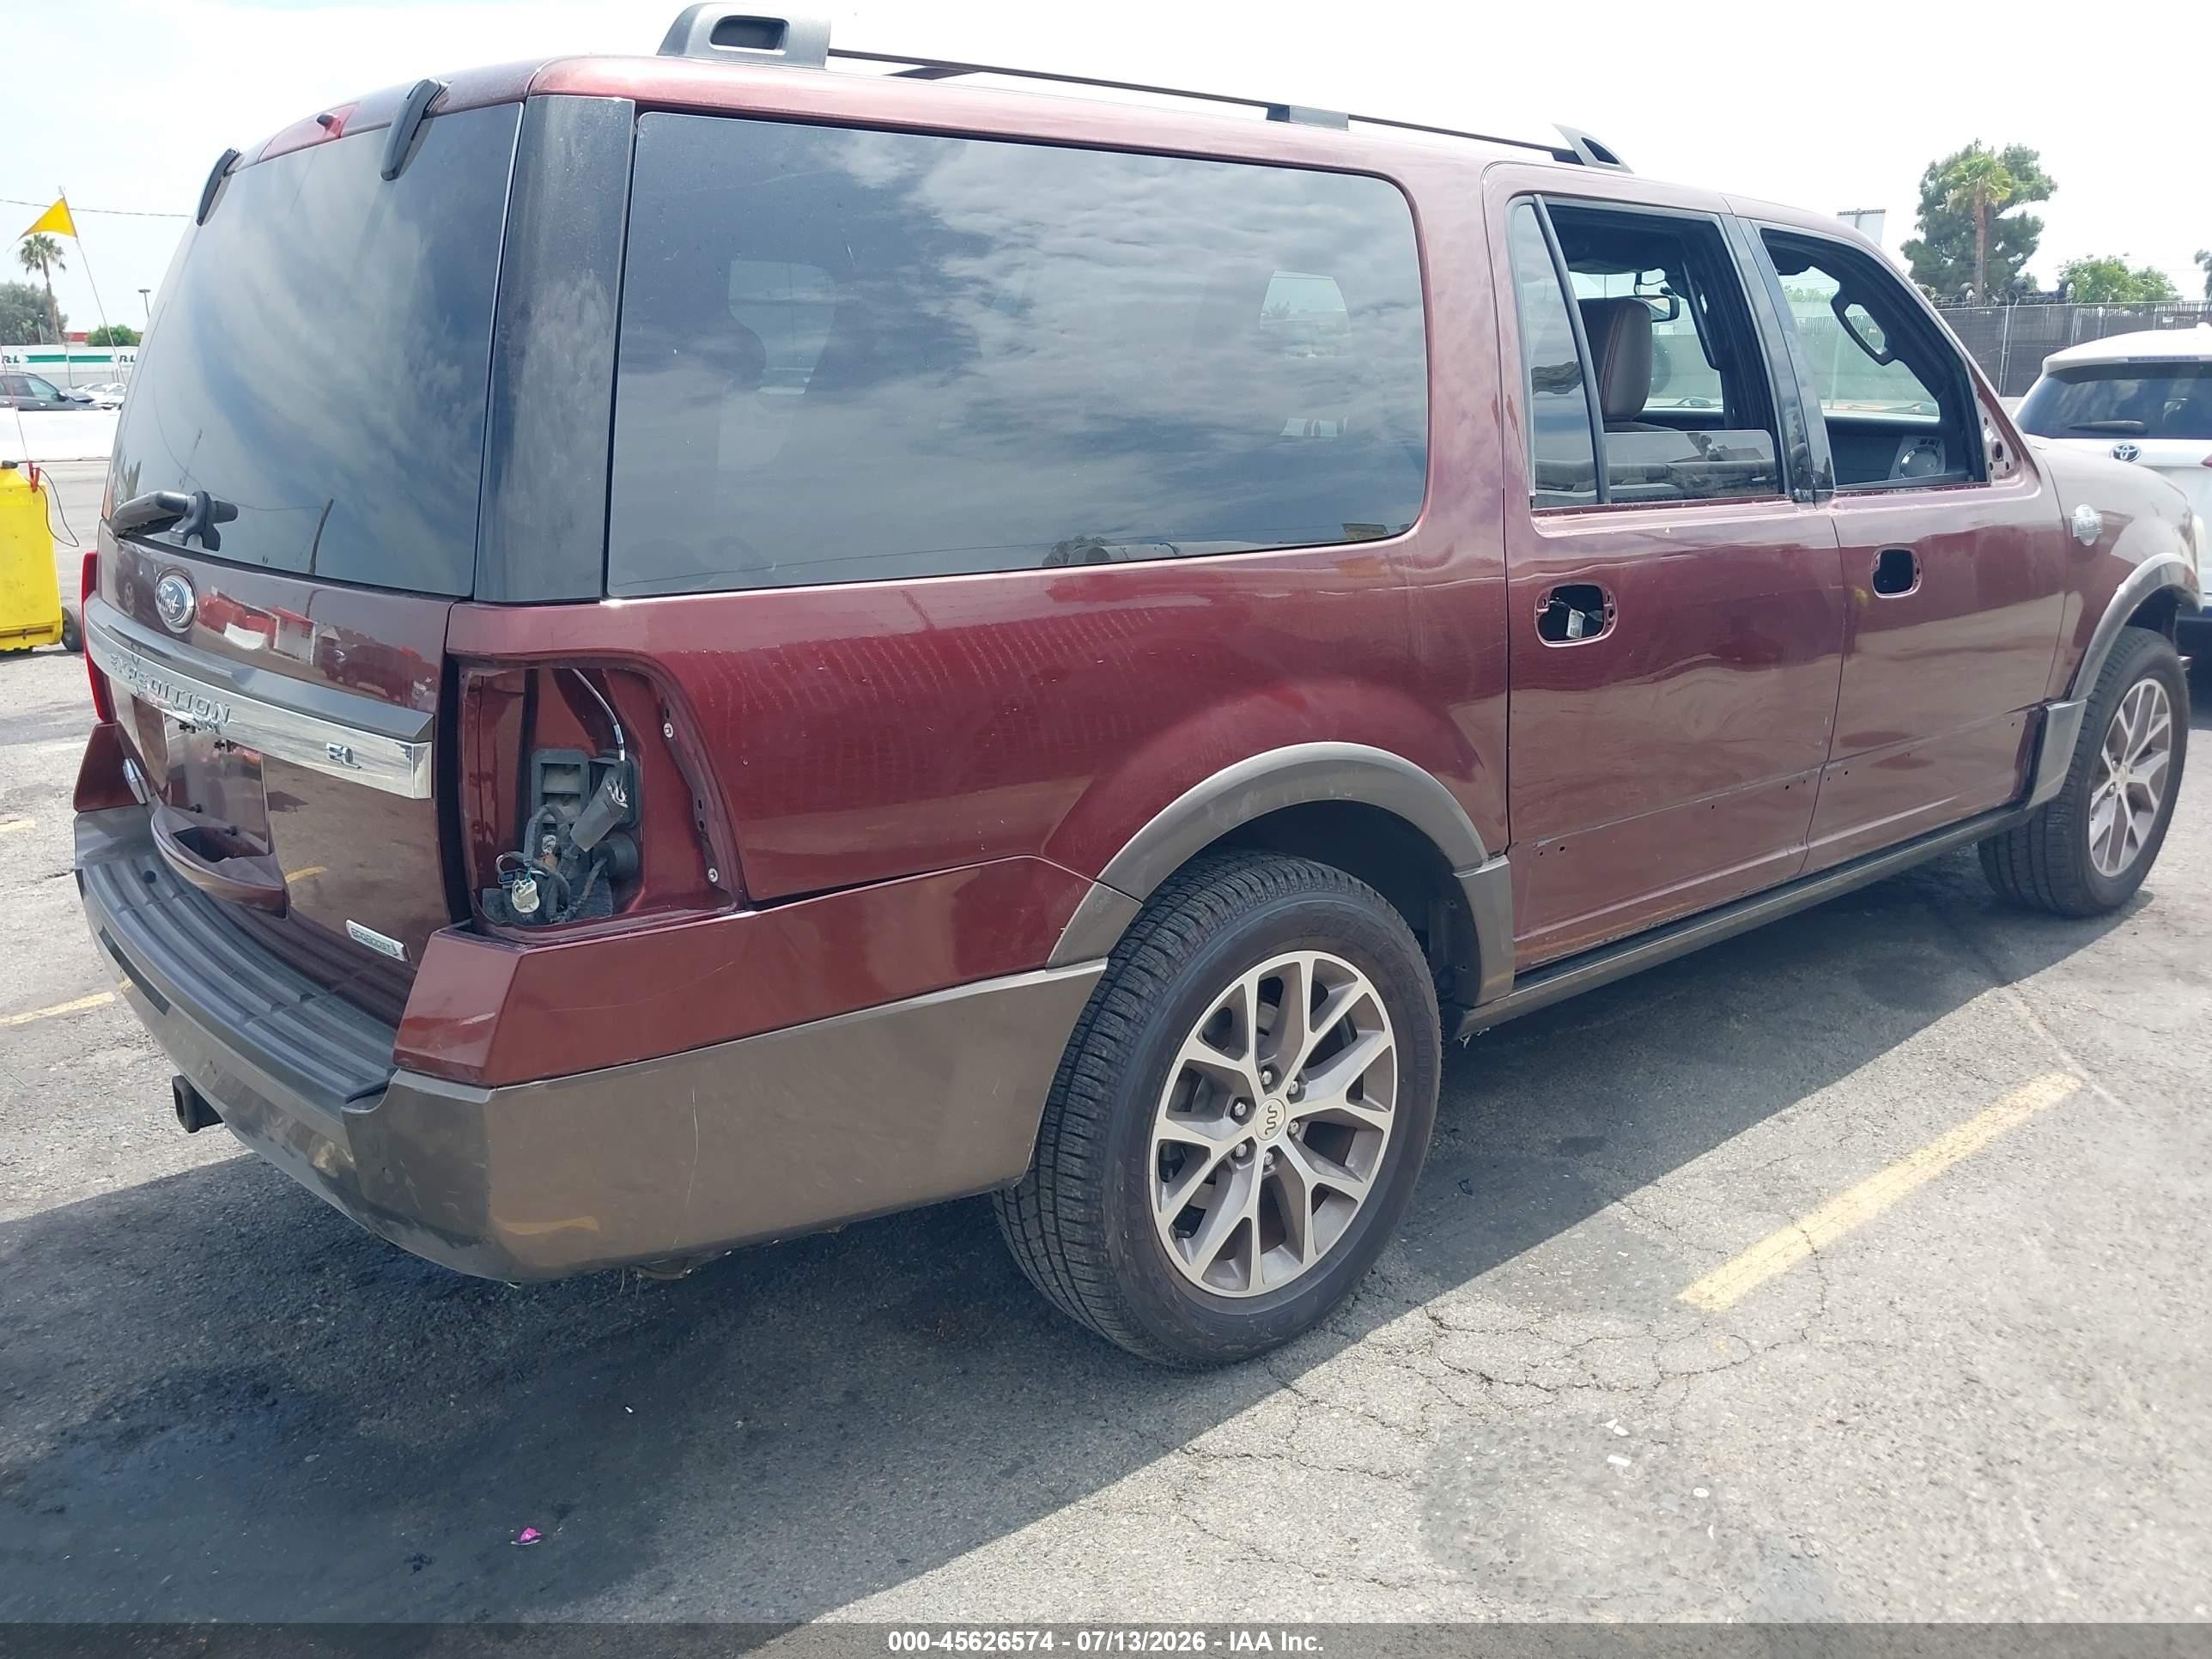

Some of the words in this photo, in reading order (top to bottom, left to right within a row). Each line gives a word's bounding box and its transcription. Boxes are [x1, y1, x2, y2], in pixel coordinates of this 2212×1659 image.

[157, 583, 180, 615] Ford
[110, 653, 231, 726] EXPEDITION
[326, 742, 362, 769] EL
